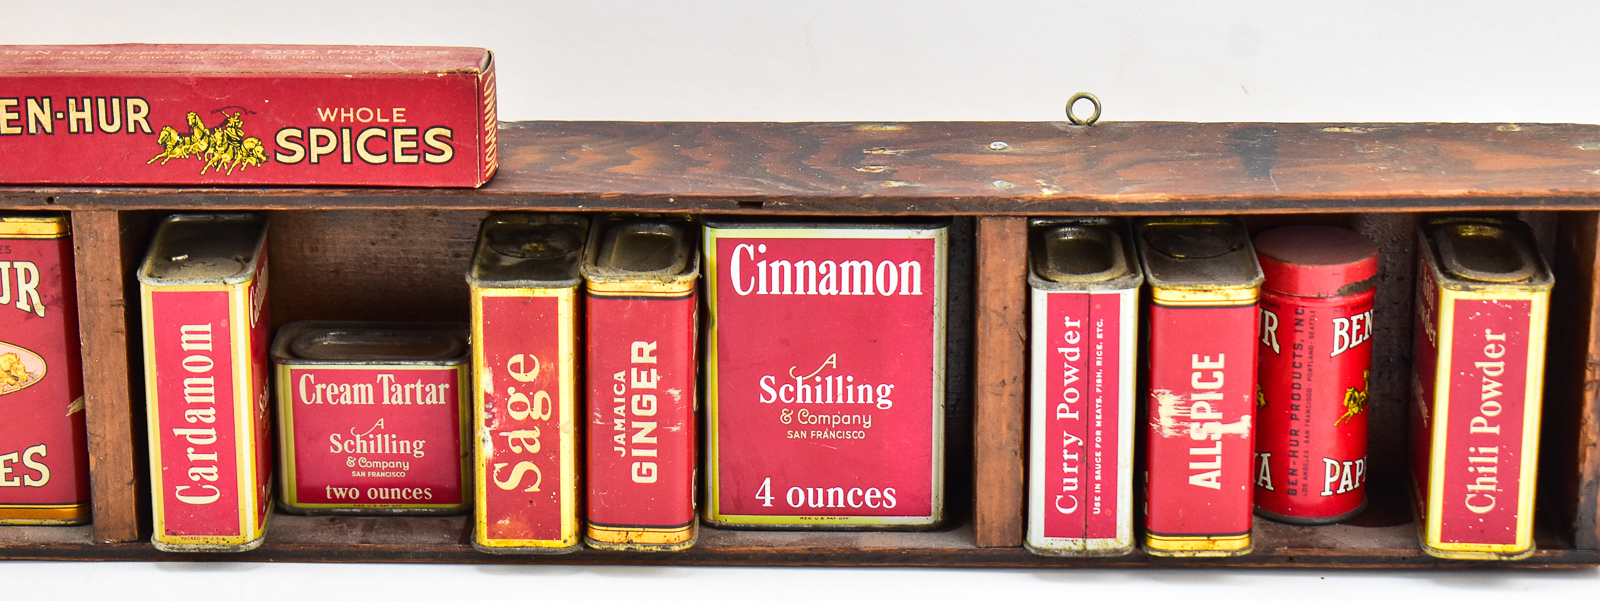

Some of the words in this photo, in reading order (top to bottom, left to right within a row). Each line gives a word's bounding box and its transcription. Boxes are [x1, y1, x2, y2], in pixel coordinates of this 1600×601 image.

[317, 107, 406, 123] WHOLE
[483, 72, 498, 178] CINNAMON
[274, 126, 455, 165] SPICES
[730, 242, 922, 296] Cinnamon
[299, 373, 375, 405] Cream
[376, 373, 449, 405] Tartar
[759, 374, 895, 410] Schilling
[1056, 316, 1081, 420] Powder
[1290, 339, 1305, 421] PRODUCTS,
[1470, 328, 1506, 435] Powder
[175, 323, 220, 505] Cardamom
[493, 353, 553, 493] Sage
[613, 369, 626, 458] JAMAICA
[631, 340, 658, 484] GINGER
[780, 408, 794, 424] &
[797, 408, 872, 428] Company
[786, 430, 808, 439] SAN
[811, 430, 866, 439] FRANCISCO
[1188, 353, 1225, 490] ALLSPICE
[329, 433, 425, 458] Schilling
[346, 457, 356, 468] &
[358, 457, 410, 470] Company
[1094, 451, 1102, 481] SAUCE
[1287, 428, 1300, 496] BEN-HUR
[326, 484, 360, 500] two
[367, 485, 433, 500] ounces
[755, 477, 775, 507] 4
[786, 485, 897, 508] ounces
[1055, 432, 1084, 515] Curry
[1094, 483, 1101, 493] IN
[1465, 445, 1498, 514] Chili
